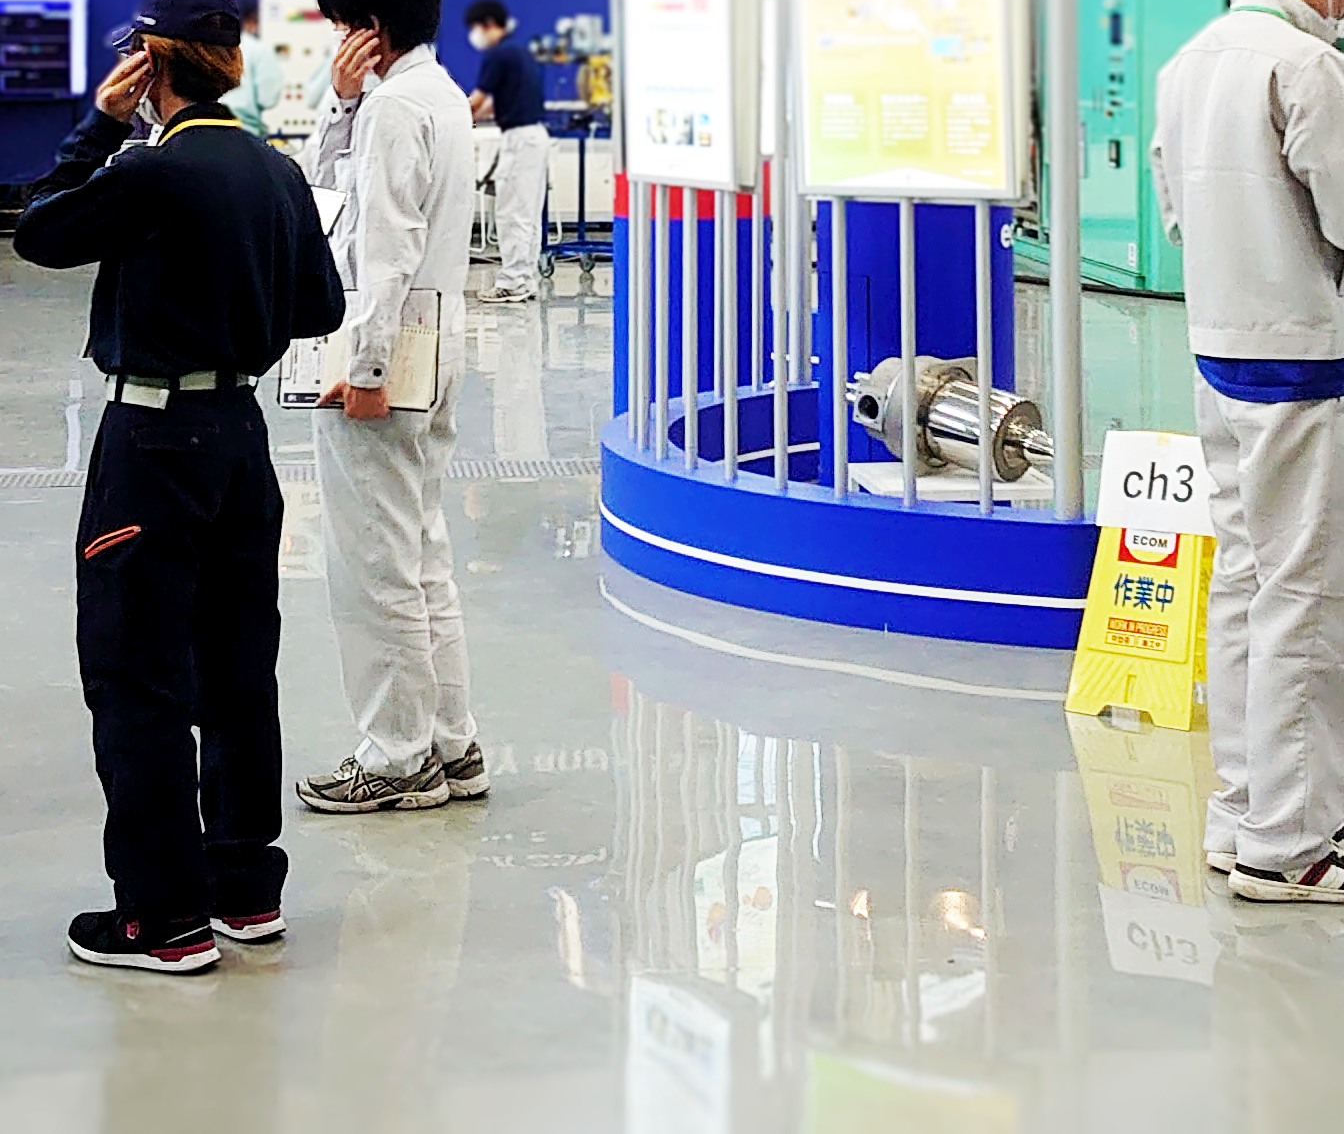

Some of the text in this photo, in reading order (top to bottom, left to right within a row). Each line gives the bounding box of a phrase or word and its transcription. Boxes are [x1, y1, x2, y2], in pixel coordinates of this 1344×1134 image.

[1123, 462, 1194, 503] ch3
[1133, 535, 1168, 548] ECOM
[1114, 573, 1175, 612] 作業中
